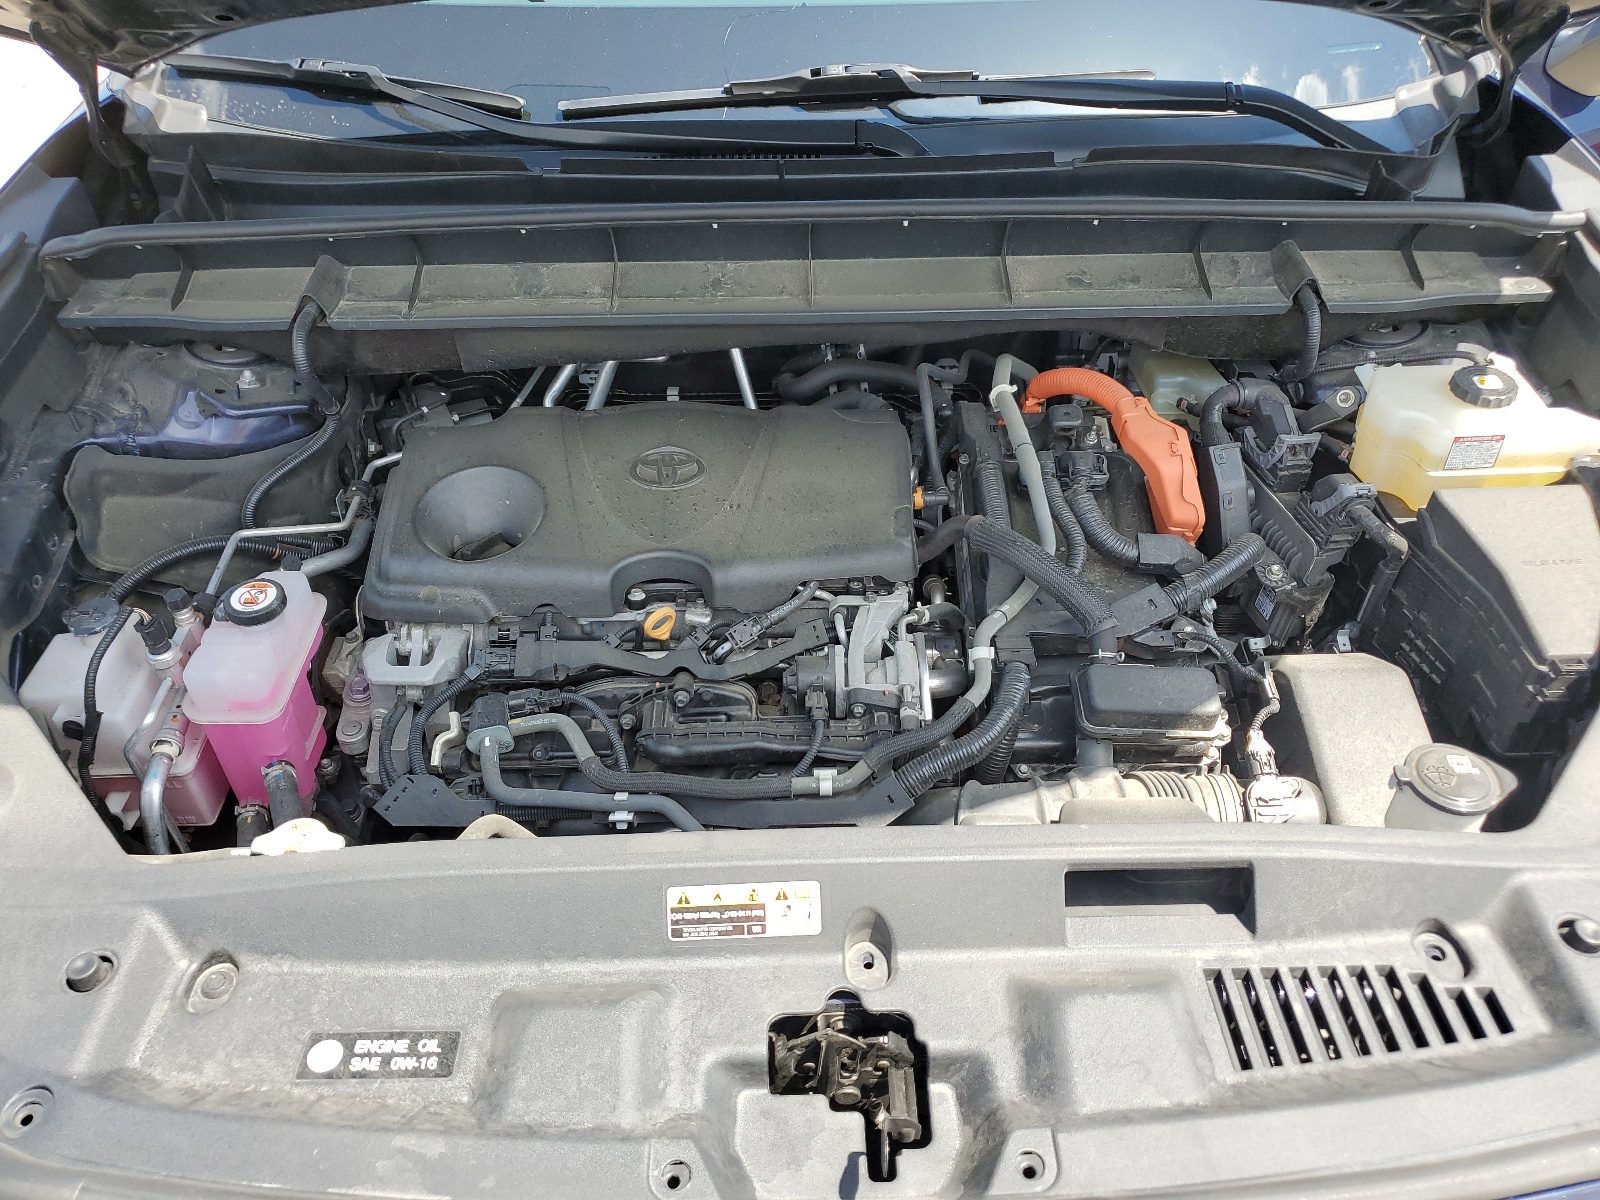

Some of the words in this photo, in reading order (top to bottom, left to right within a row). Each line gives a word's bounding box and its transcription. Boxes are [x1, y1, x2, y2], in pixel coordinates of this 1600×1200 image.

[353, 1039, 410, 1054] ENGINE
[417, 1038, 441, 1053] OIL
[349, 1056, 382, 1071] SAE
[389, 1055, 439, 1070] 0W-16
